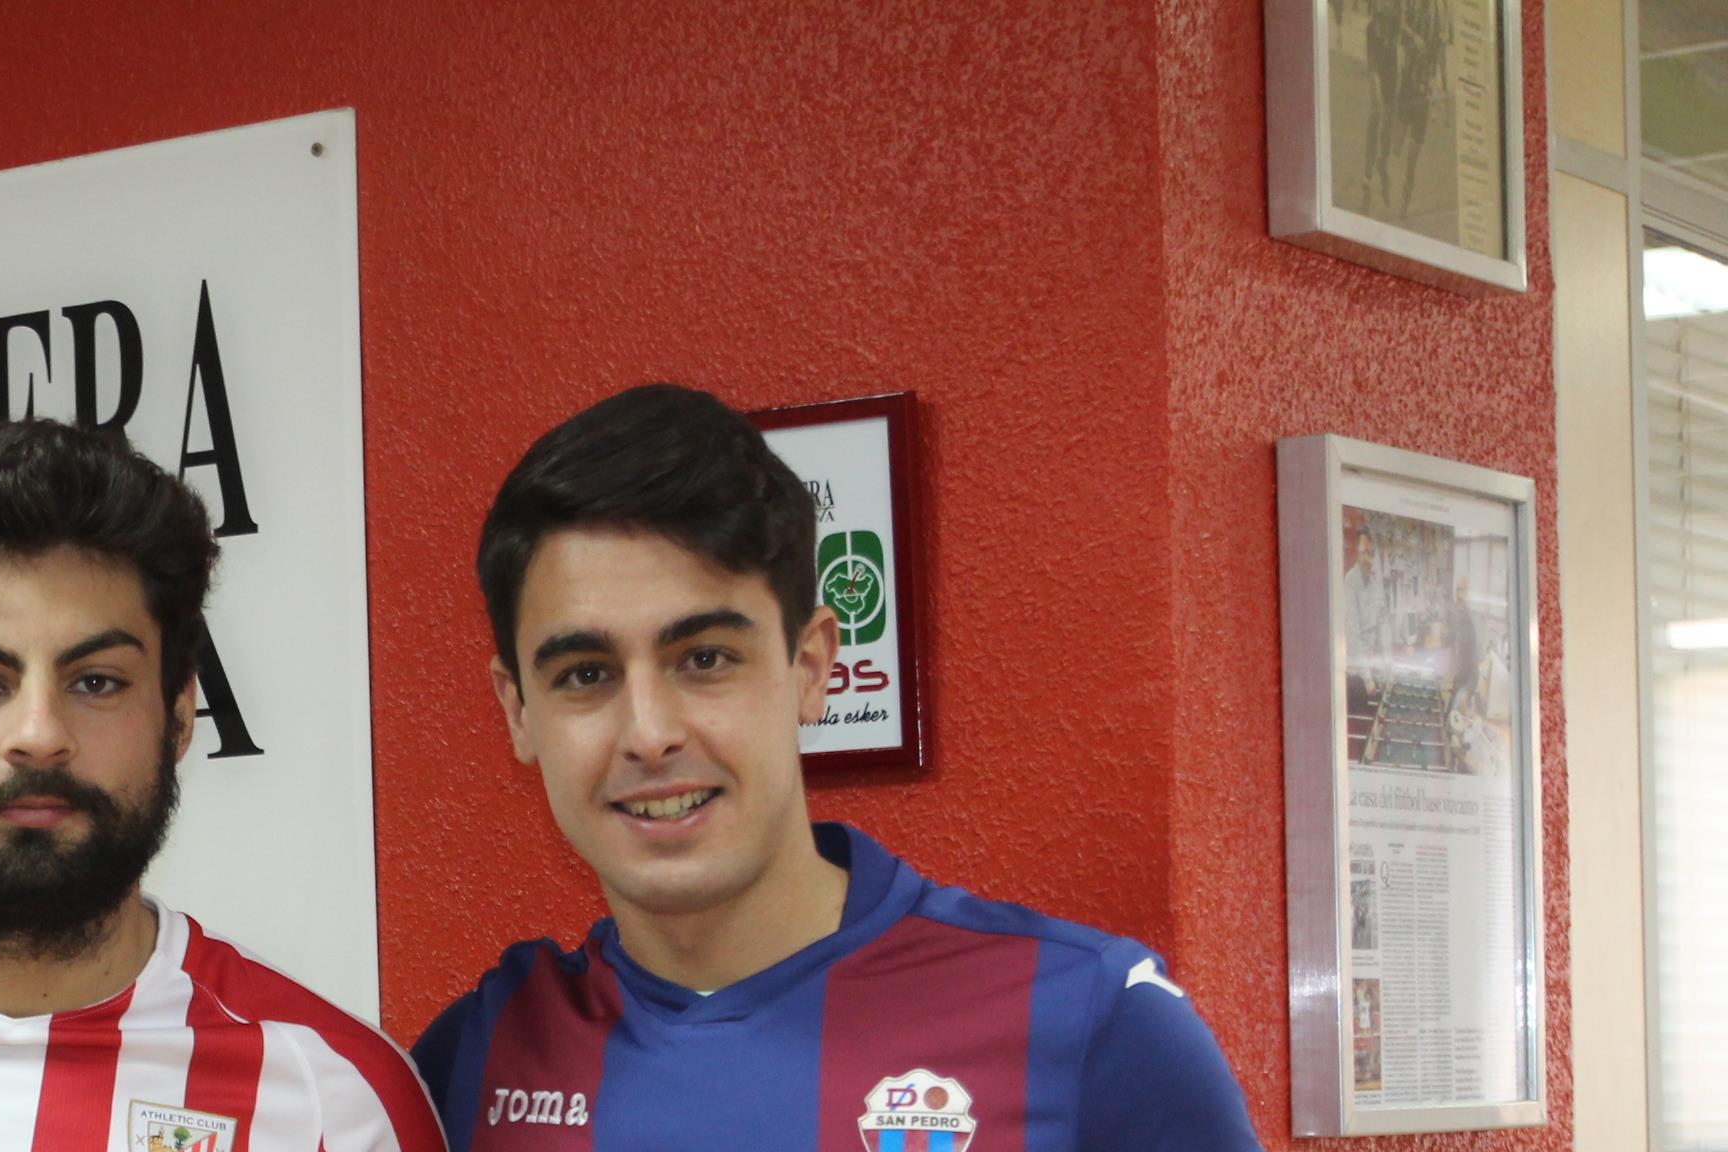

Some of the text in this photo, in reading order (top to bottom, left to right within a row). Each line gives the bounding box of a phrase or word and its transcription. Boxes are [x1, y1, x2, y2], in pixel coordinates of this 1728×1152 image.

[844, 701, 889, 725] esker
[140, 1110, 227, 1131] ATHLETIC CLUB
[876, 1115, 960, 1128] SAN PEDRO
